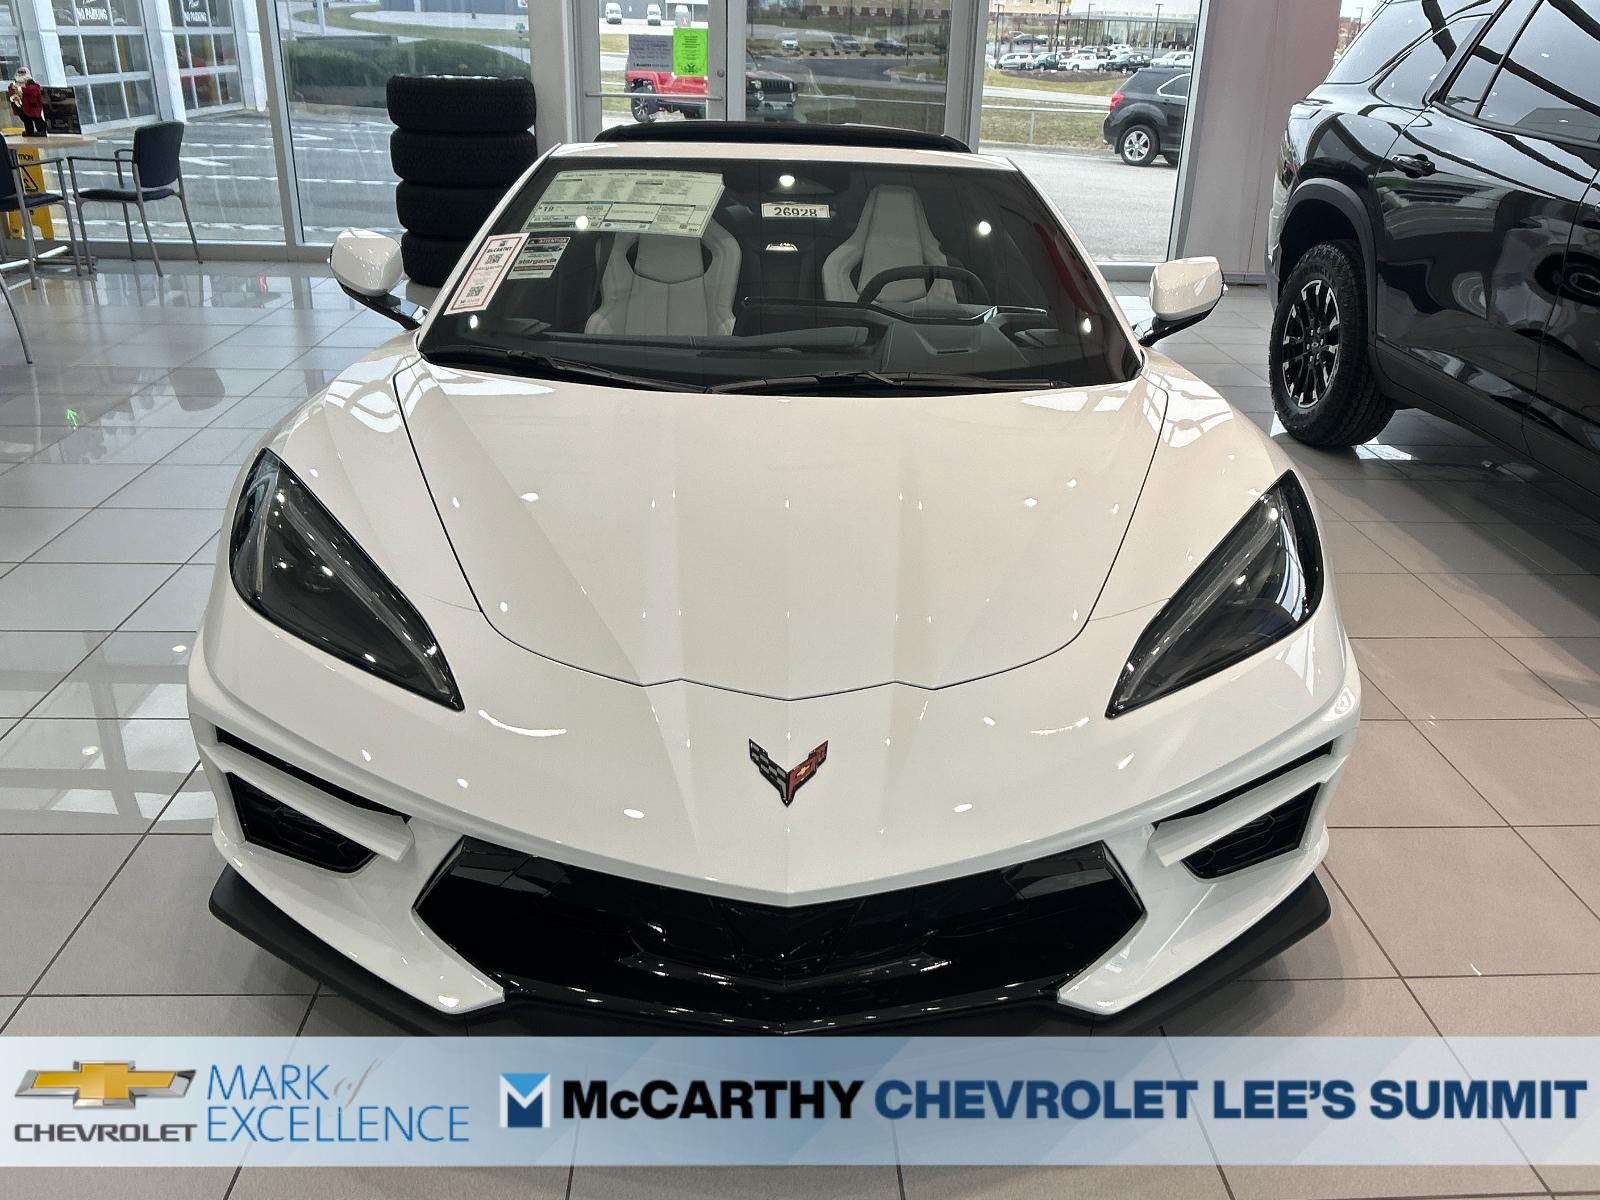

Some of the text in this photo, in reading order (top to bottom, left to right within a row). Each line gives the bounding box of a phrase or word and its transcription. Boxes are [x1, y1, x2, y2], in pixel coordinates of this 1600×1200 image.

[86, 7, 108, 20] PARKING
[190, 11, 207, 22] PARKING
[774, 206, 818, 217] 26928
